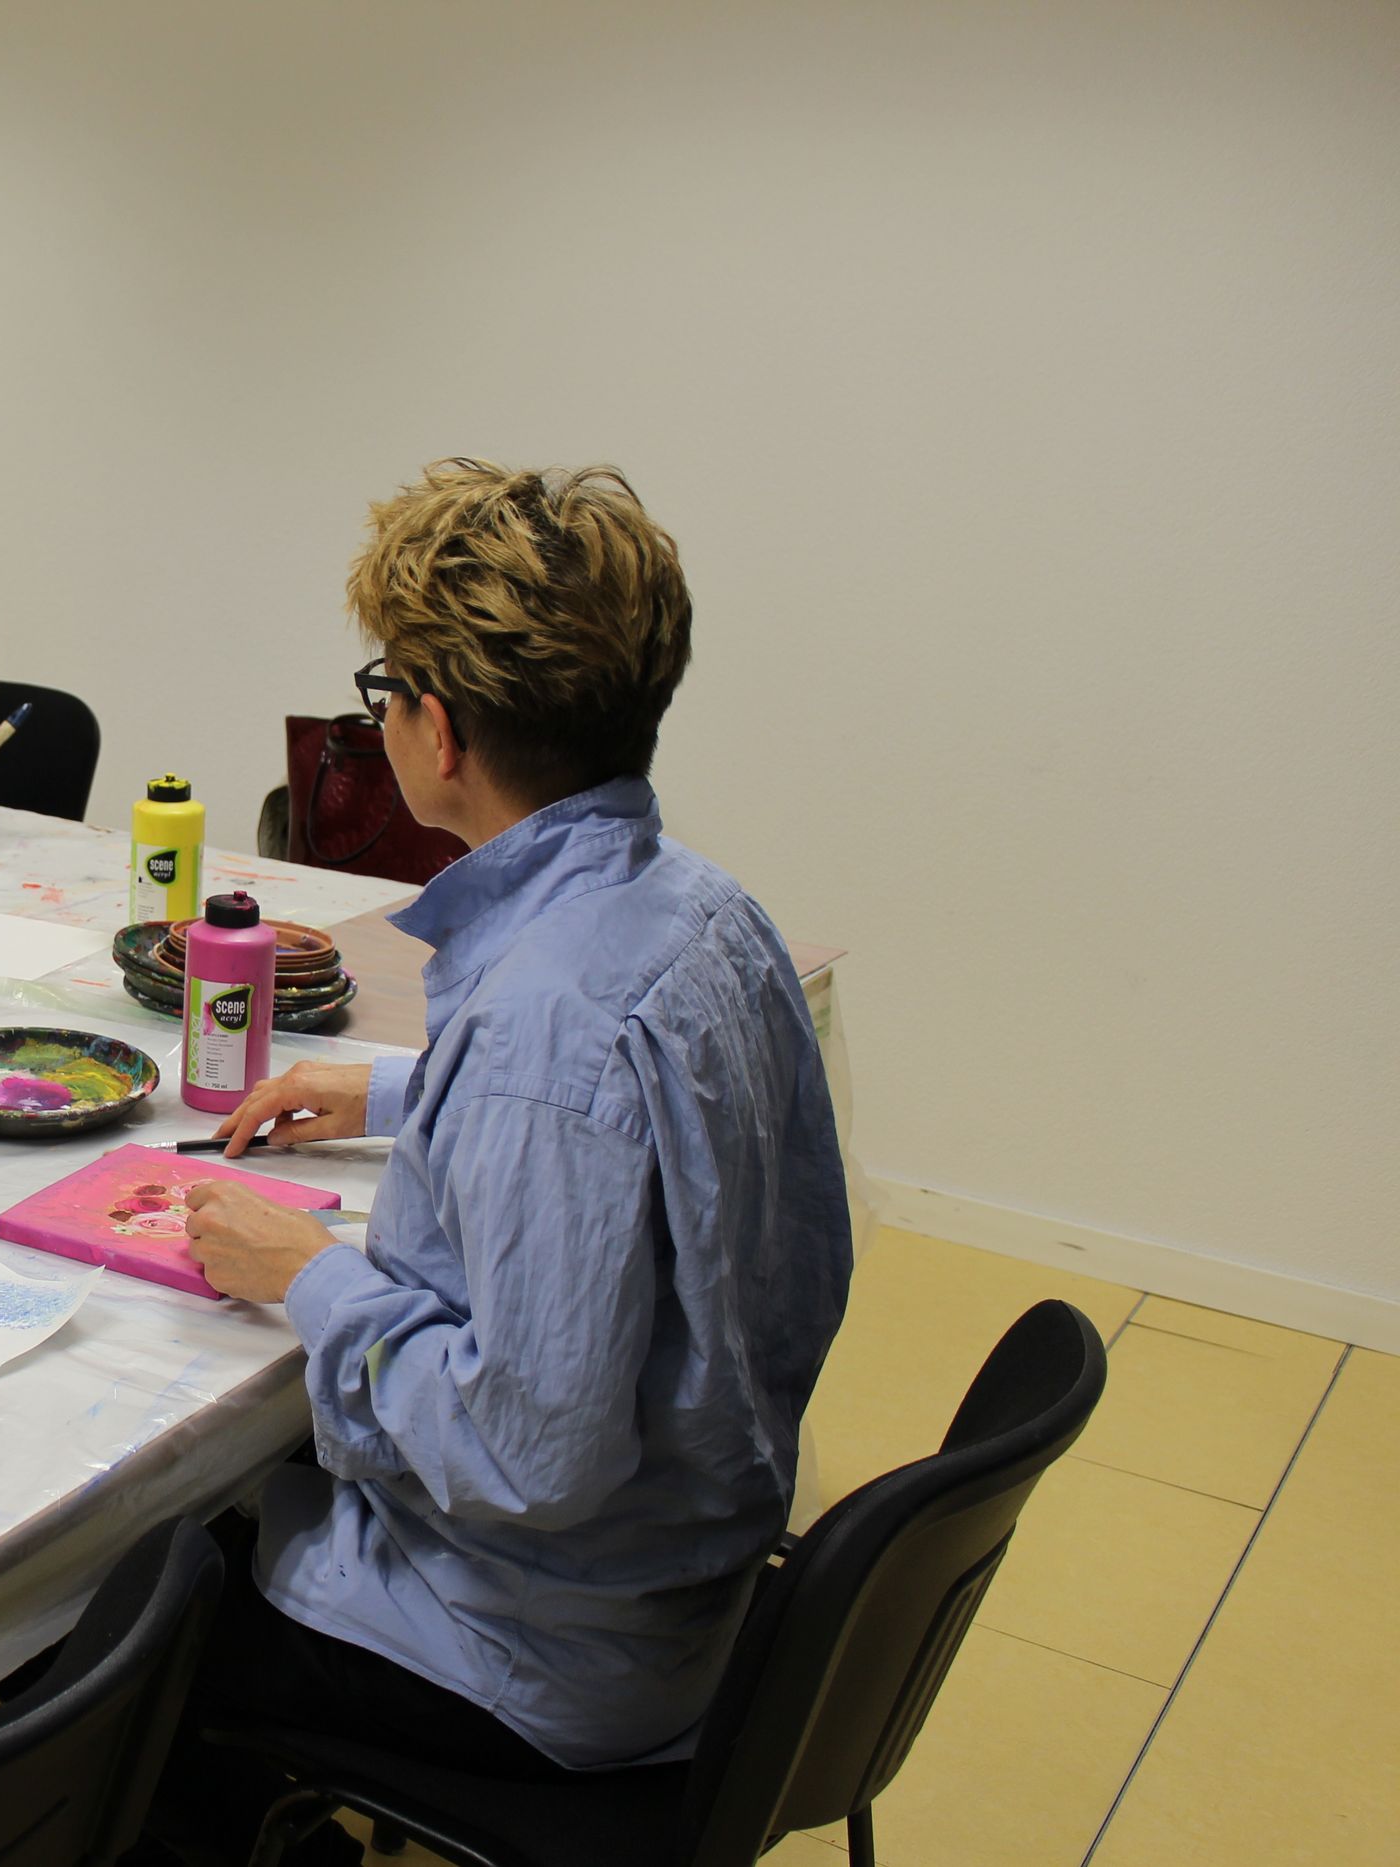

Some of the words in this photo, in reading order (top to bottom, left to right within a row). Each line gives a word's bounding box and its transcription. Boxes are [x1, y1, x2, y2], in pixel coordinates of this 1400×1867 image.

[149, 859, 174, 871] scene
[215, 1000, 246, 1015] scene
[220, 1014, 242, 1024] acryl
